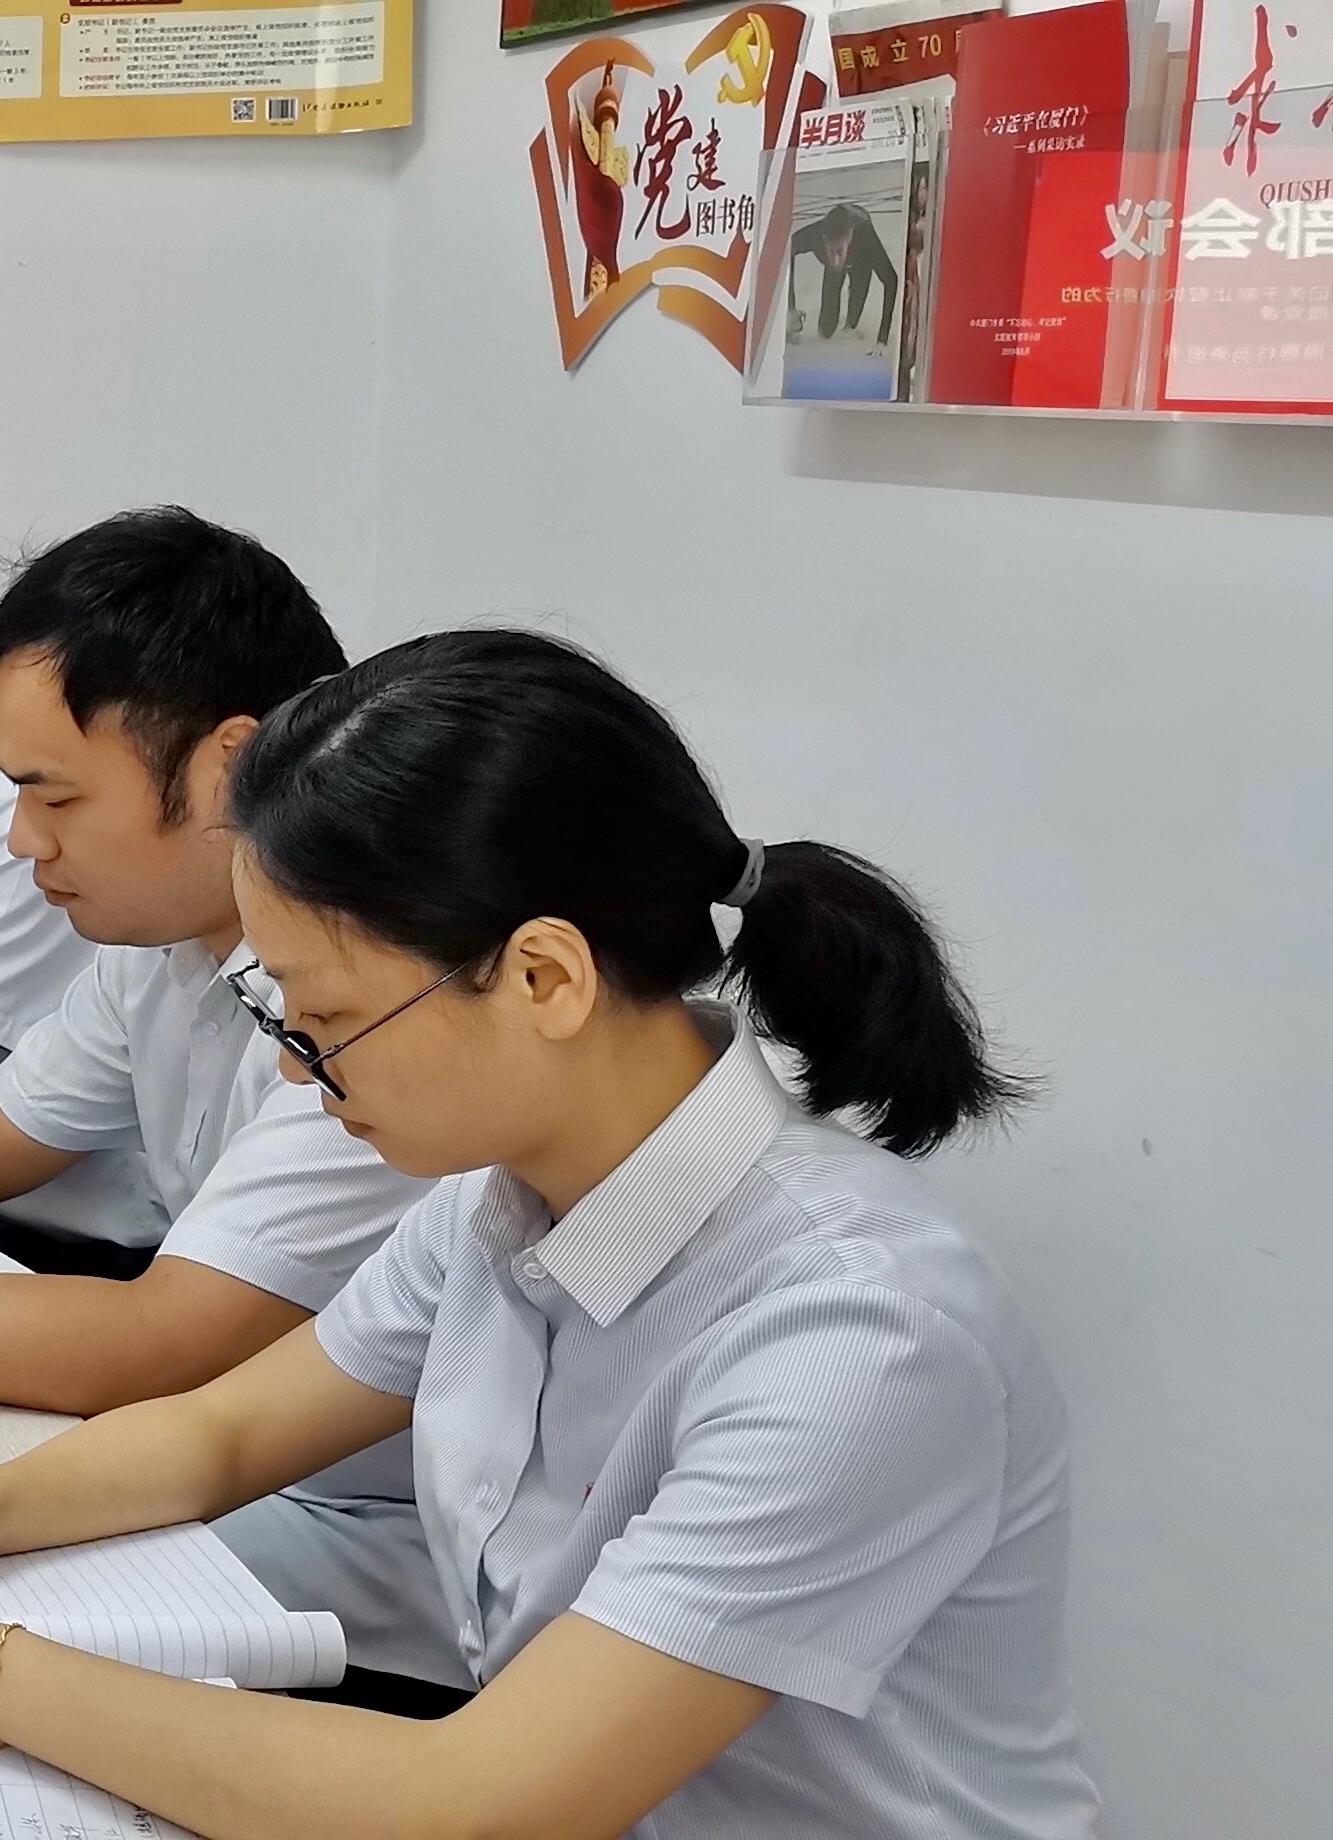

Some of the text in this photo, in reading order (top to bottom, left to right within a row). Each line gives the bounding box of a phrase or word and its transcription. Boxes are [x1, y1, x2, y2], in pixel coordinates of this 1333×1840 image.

[837, 28, 962, 71] 国成立70
[801, 109, 866, 150] 半月谈
[633, 84, 726, 241] 党建
[695, 193, 755, 237] 图书角
